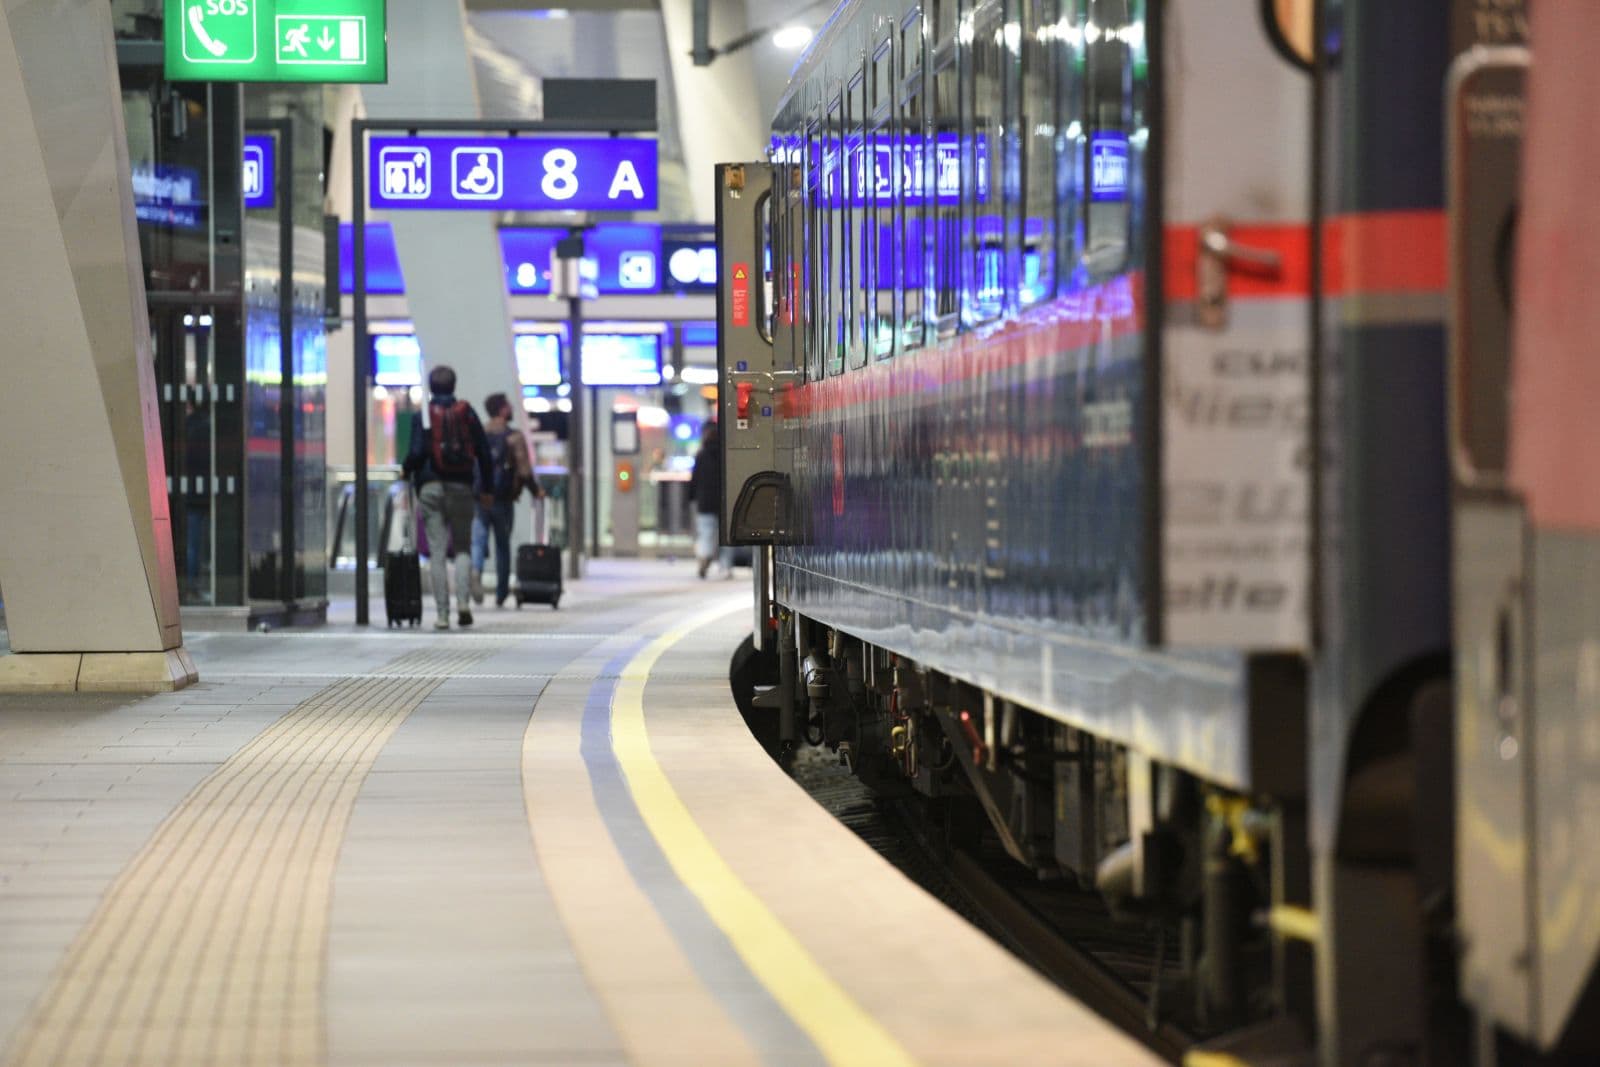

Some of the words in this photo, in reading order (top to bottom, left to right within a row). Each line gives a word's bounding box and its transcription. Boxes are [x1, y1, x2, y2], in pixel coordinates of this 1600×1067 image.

[206, 0, 248, 15] SOS
[541, 148, 578, 200] 8
[608, 160, 644, 199] A
